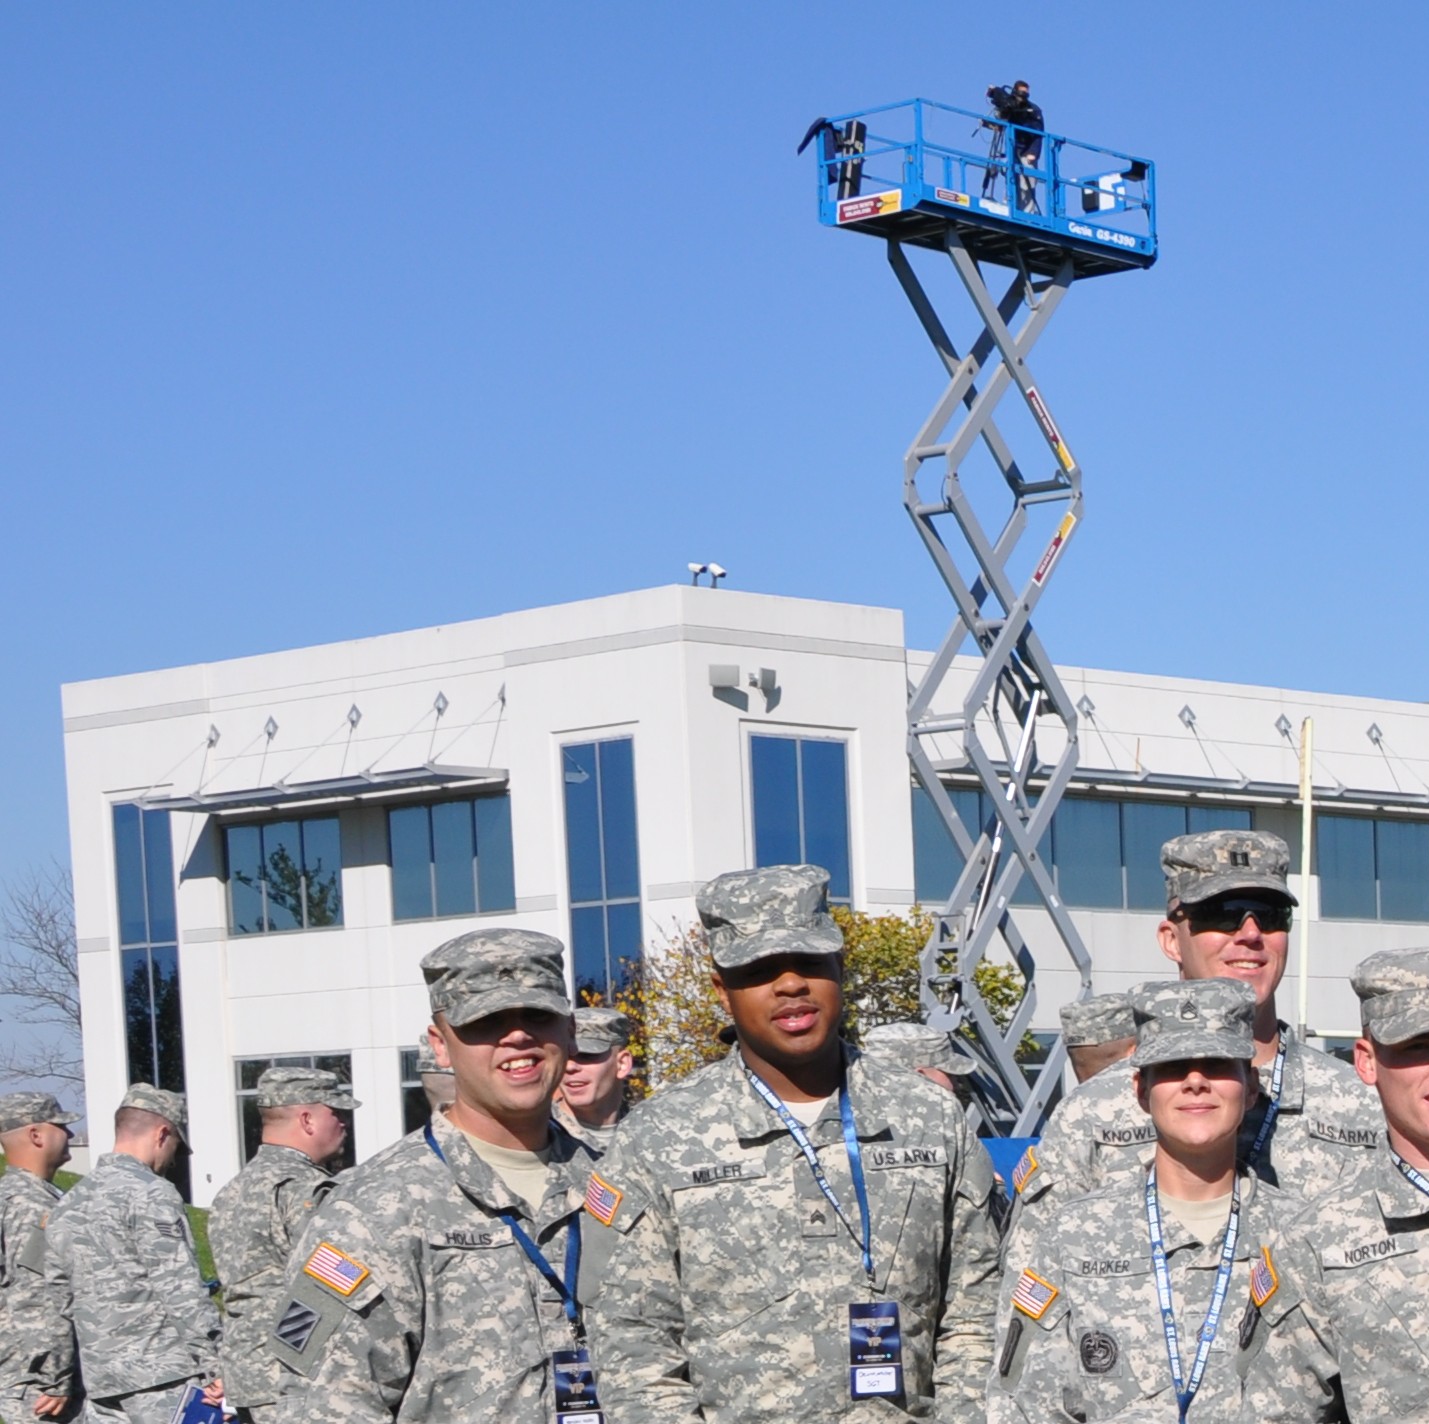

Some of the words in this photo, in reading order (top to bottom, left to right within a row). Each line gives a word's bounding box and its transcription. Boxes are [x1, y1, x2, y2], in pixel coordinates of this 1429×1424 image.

[1102, 1127, 1156, 1142] KNOWL
[1338, 1129, 1378, 1144] ARMY
[872, 1151, 900, 1166] U.S.
[904, 1149, 939, 1164] ARMY
[692, 1164, 742, 1184] MILLER
[446, 1232, 492, 1246] HOLLIS
[1344, 1238, 1397, 1264] NORTON
[1082, 1260, 1130, 1275] BARKER
